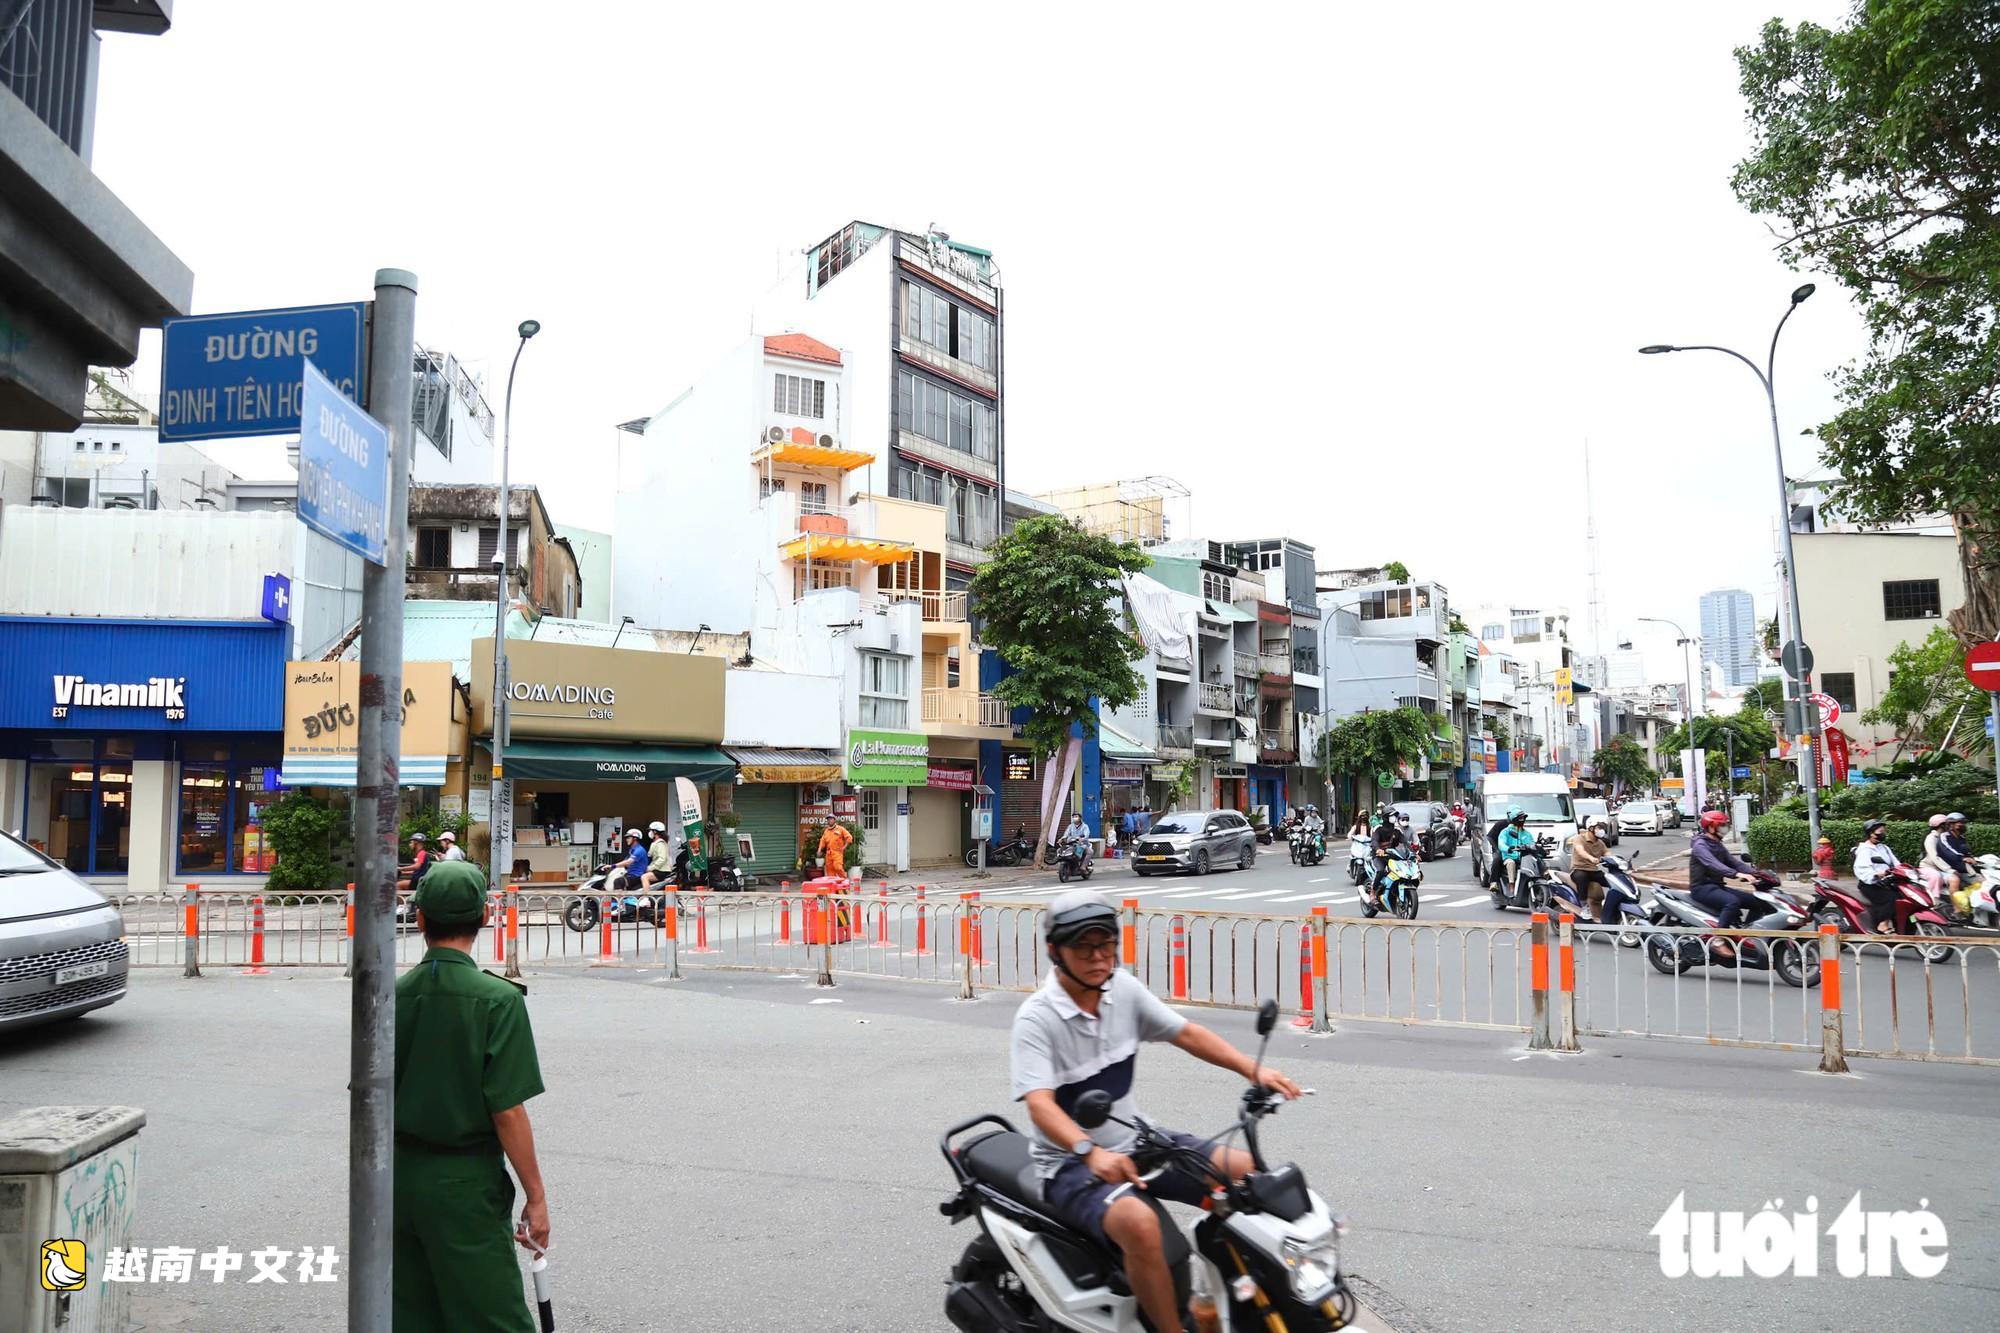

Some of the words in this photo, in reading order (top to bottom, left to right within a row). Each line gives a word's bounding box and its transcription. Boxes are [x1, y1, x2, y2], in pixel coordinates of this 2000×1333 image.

[204, 326, 318, 363] ĐƯỜNG
[166, 387, 216, 426] ĐINH
[224, 376, 271, 421] TIÊN
[319, 403, 369, 469] ĐƯỜNG
[53, 675, 185, 707] Vinamilk
[53, 707, 68, 718] EST
[166, 709, 185, 720] 1976
[302, 702, 355, 739] ĐỨC
[596, 762, 646, 773] NOMADING
